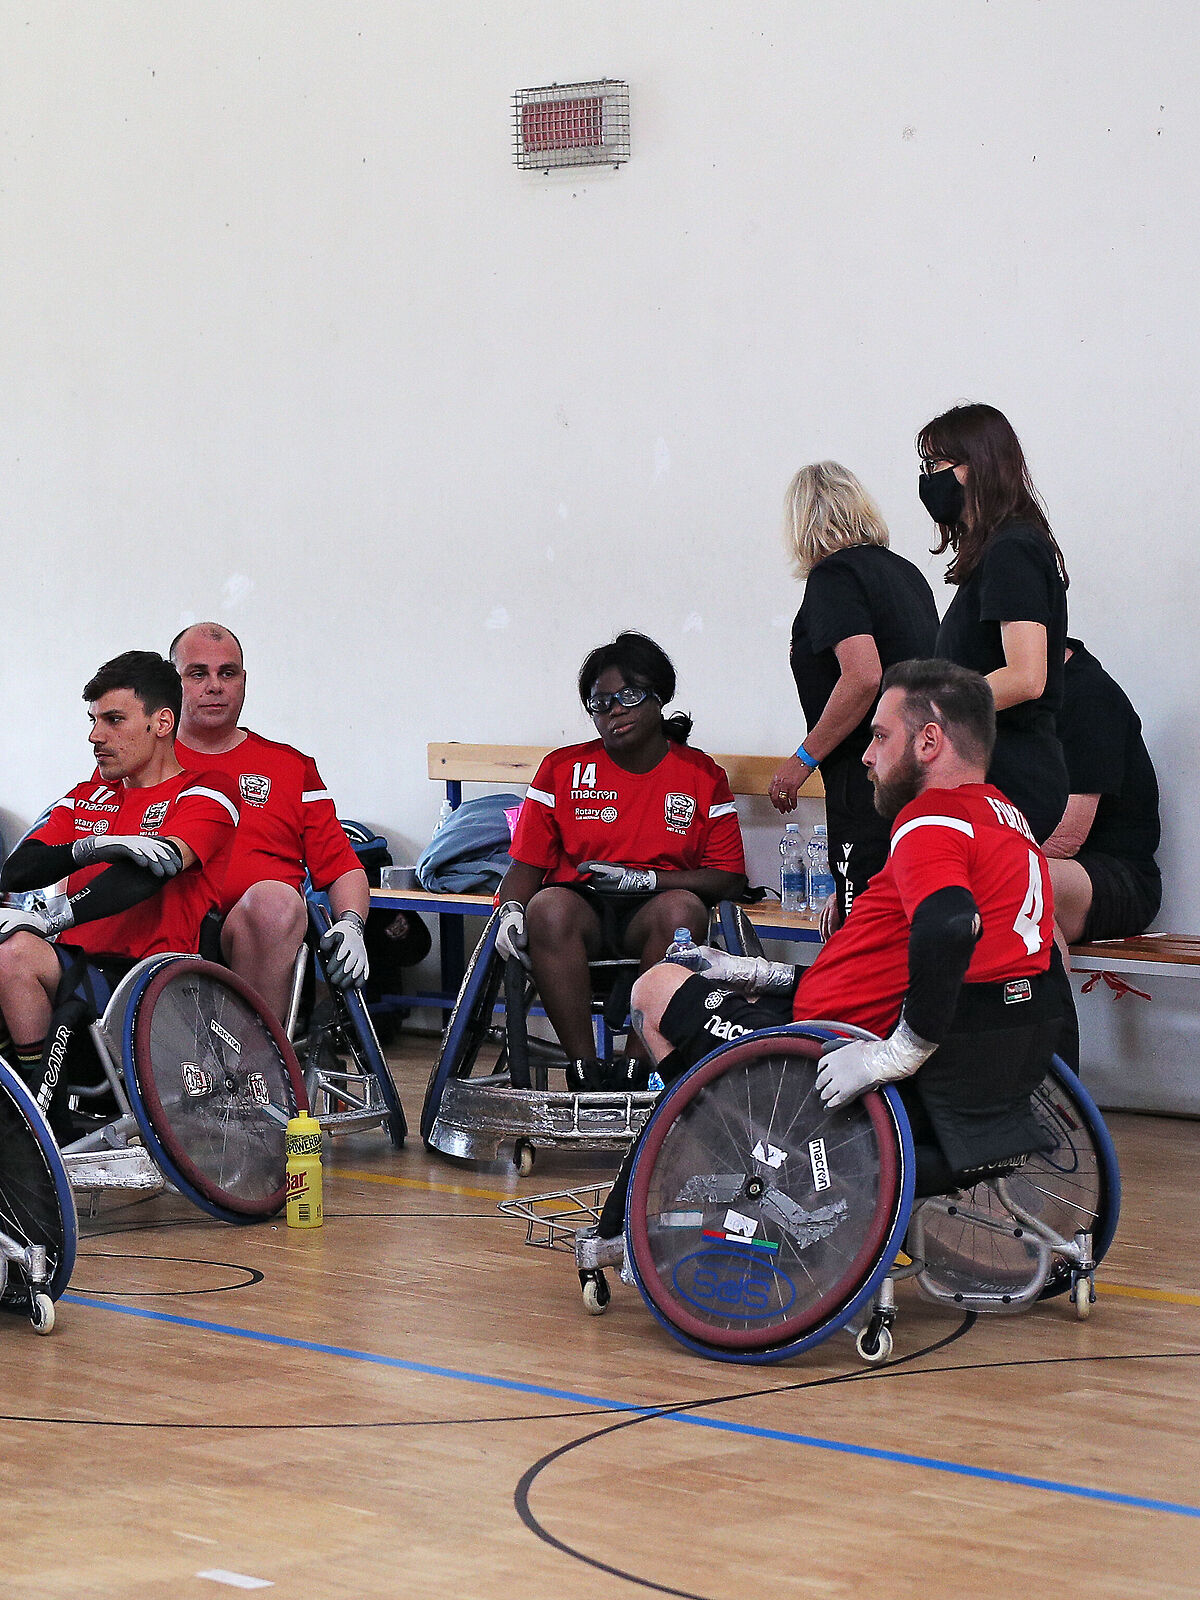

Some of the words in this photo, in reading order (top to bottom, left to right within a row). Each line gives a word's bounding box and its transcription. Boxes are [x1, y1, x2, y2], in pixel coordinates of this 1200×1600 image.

[572, 762, 597, 788] 14
[570, 789, 618, 800] macron
[76, 799, 120, 813] macron
[575, 807, 600, 817] Rotary
[74, 818, 95, 829] otary
[1013, 849, 1044, 956] 4
[211, 1020, 241, 1053] macron
[812, 1139, 829, 1191] macron
